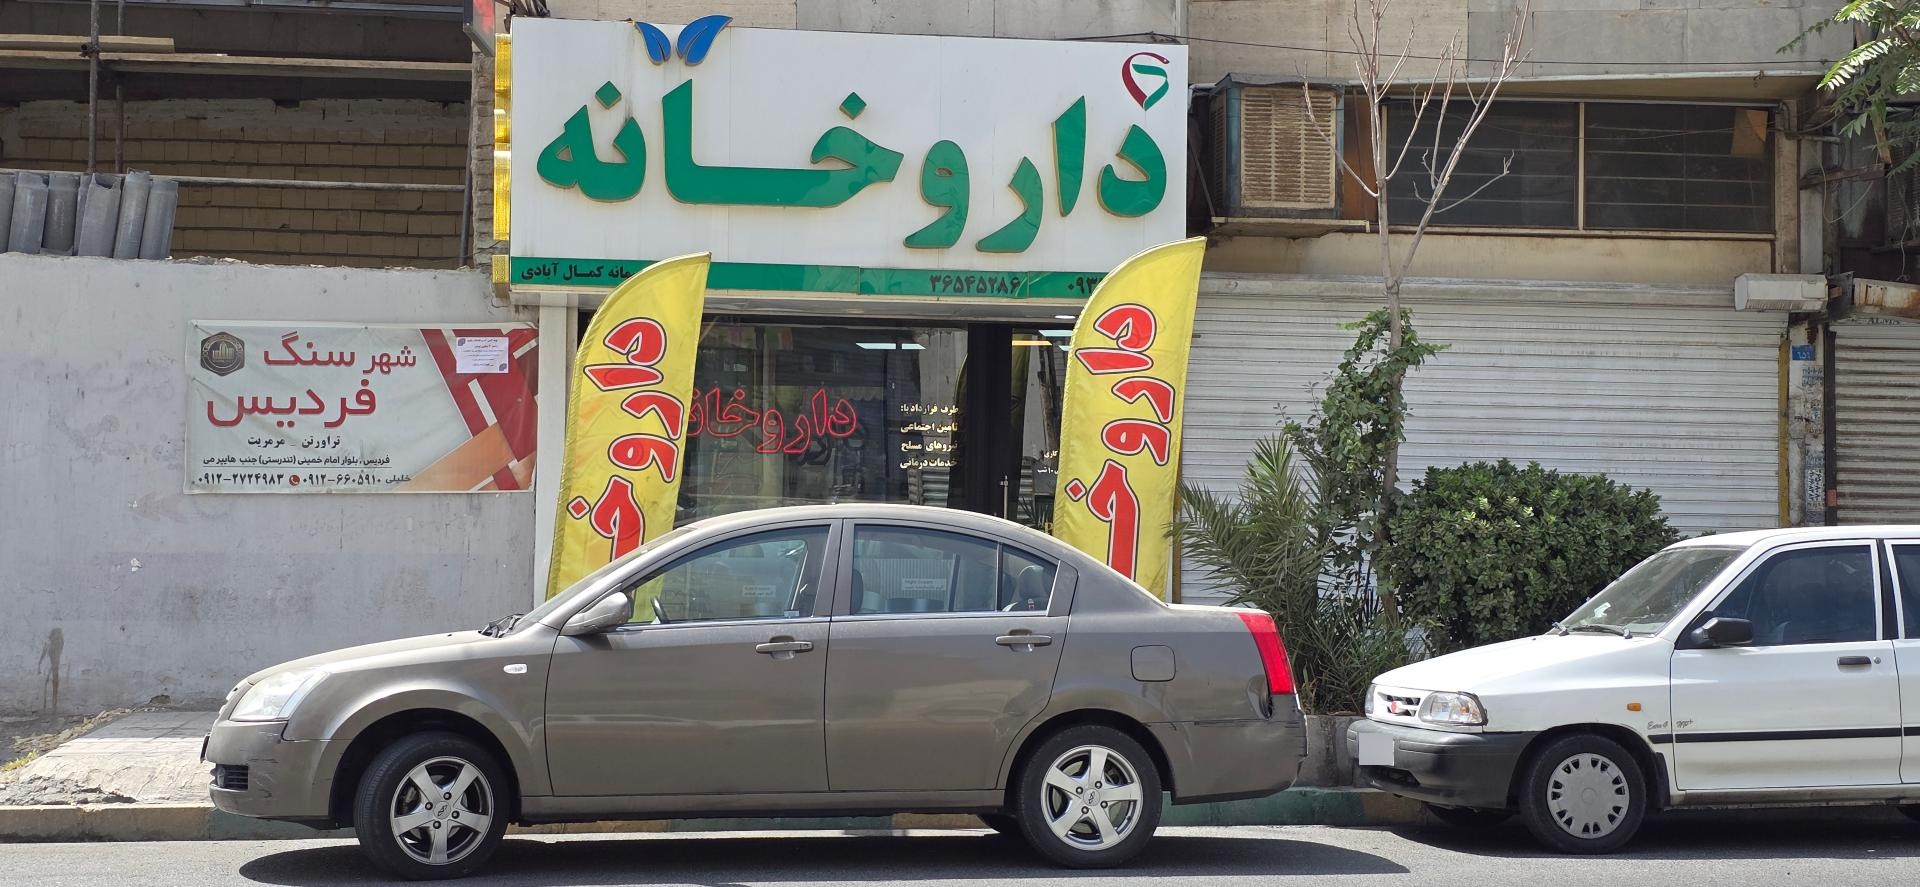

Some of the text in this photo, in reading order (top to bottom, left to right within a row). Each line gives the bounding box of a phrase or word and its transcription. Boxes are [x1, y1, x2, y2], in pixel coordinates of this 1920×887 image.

[536, 78, 1167, 253] داروخانه
[521, 262, 636, 281] مانه کمال آبادی
[929, 273, 1021, 295] ۳۶۵۴۵۲۸۶
[263, 331, 356, 368] سنگ
[362, 345, 417, 375] شهر
[207, 378, 377, 429] فردیس
[940, 405, 959, 416] طرف
[686, 386, 858, 455] داروخان
[900, 422, 935, 434] اجتماعی
[247, 435, 341, 449] تراورتن مرمریت
[567, 317, 684, 563] داروخ
[901, 440, 923, 452] مسلح
[1065, 303, 1176, 582] داروخ
[239, 457, 258, 466] جنب
[297, 456, 323, 466] خمینی
[323, 456, 340, 465] امام
[341, 456, 359, 466] بلوار
[385, 474, 412, 485] خلیلی
